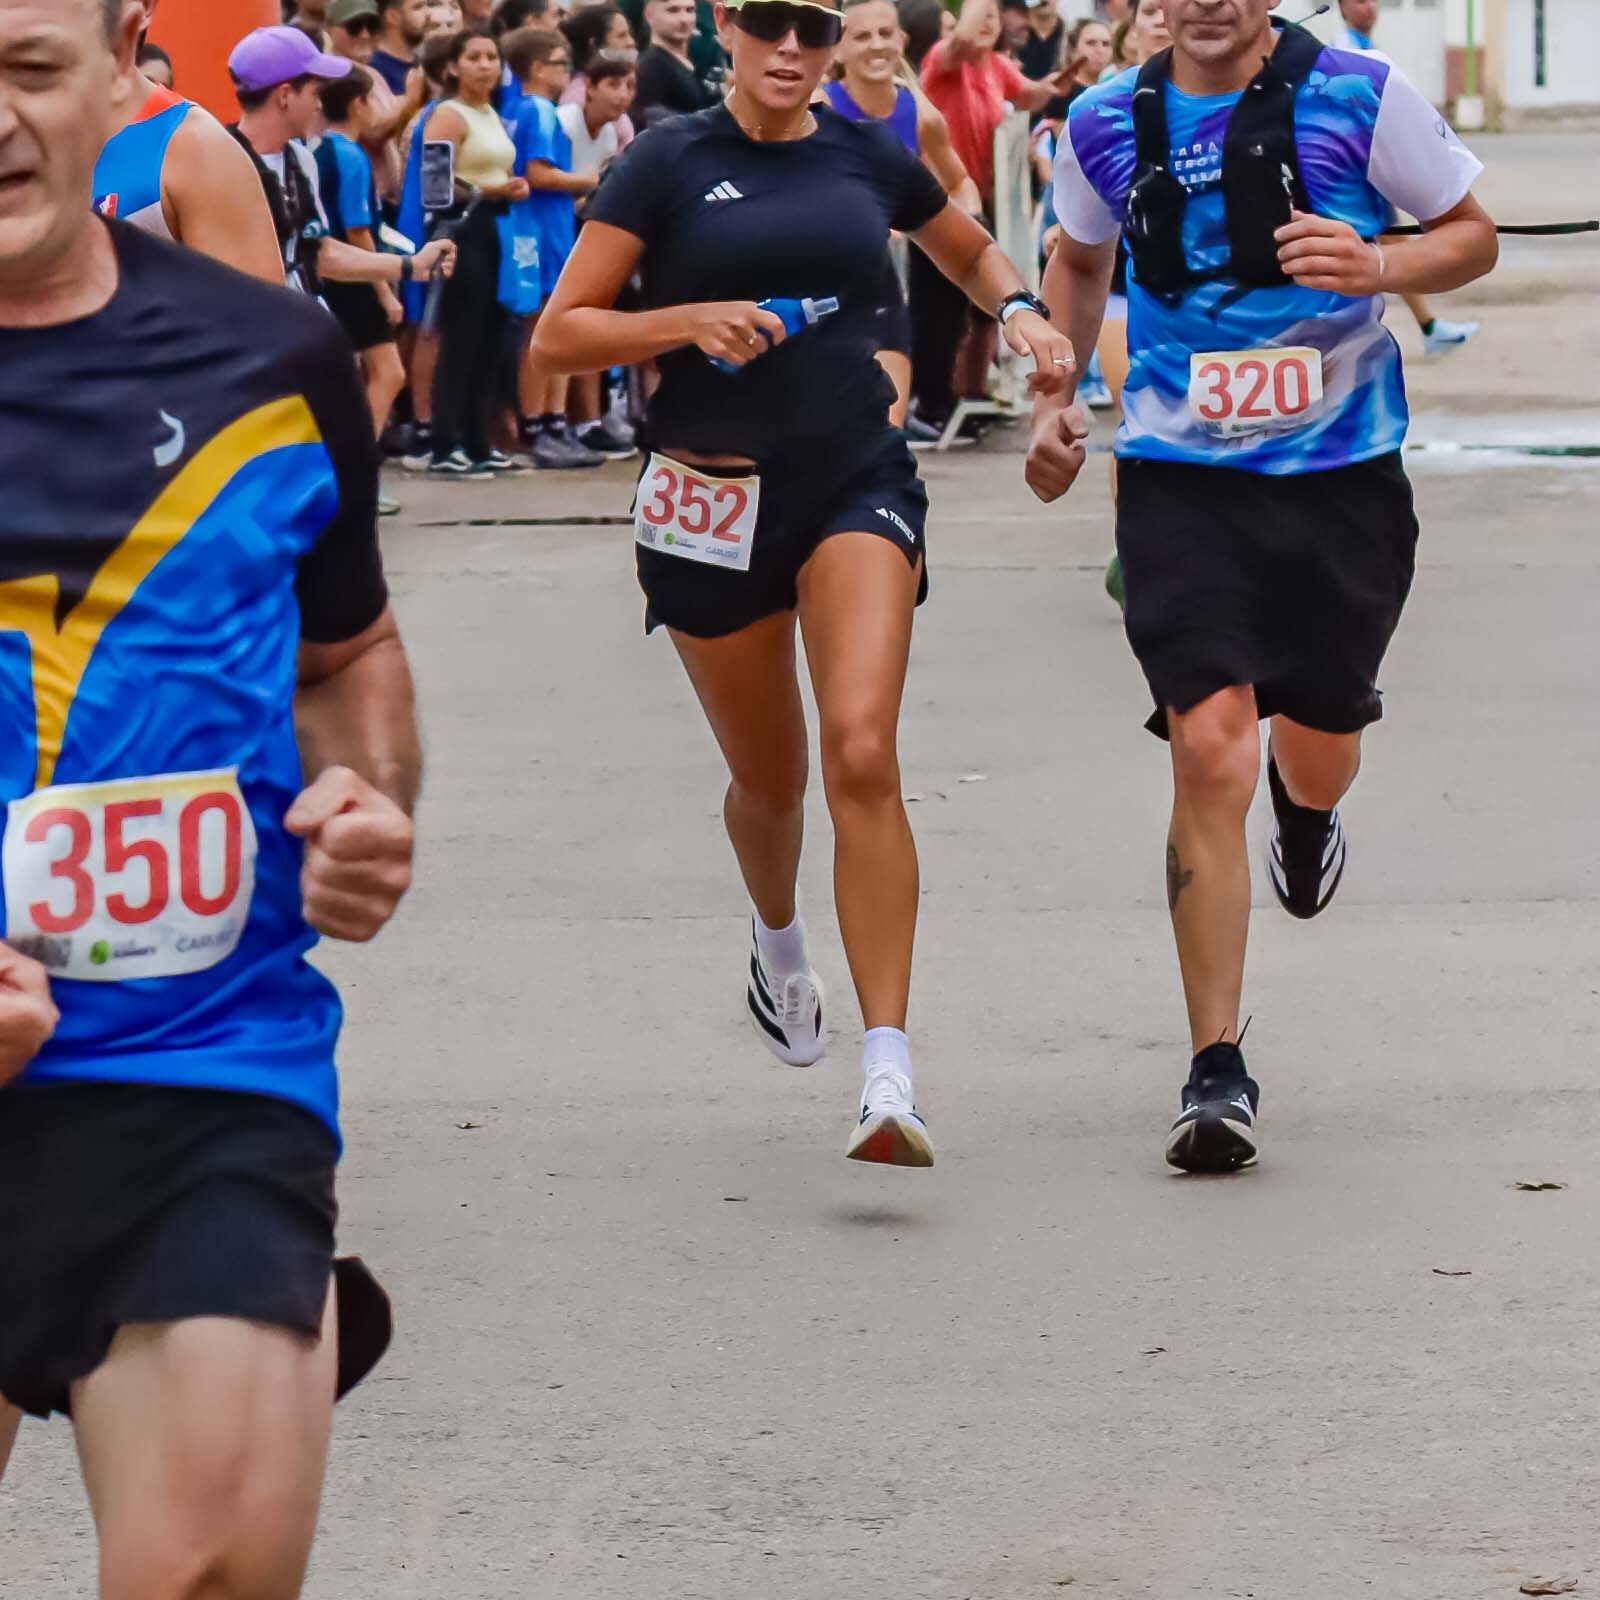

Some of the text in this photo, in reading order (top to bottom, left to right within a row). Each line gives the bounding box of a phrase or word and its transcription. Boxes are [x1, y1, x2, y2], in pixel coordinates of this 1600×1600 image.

[1198, 358, 1310, 420] 320
[642, 466, 748, 543] 352
[24, 791, 242, 933] 350
